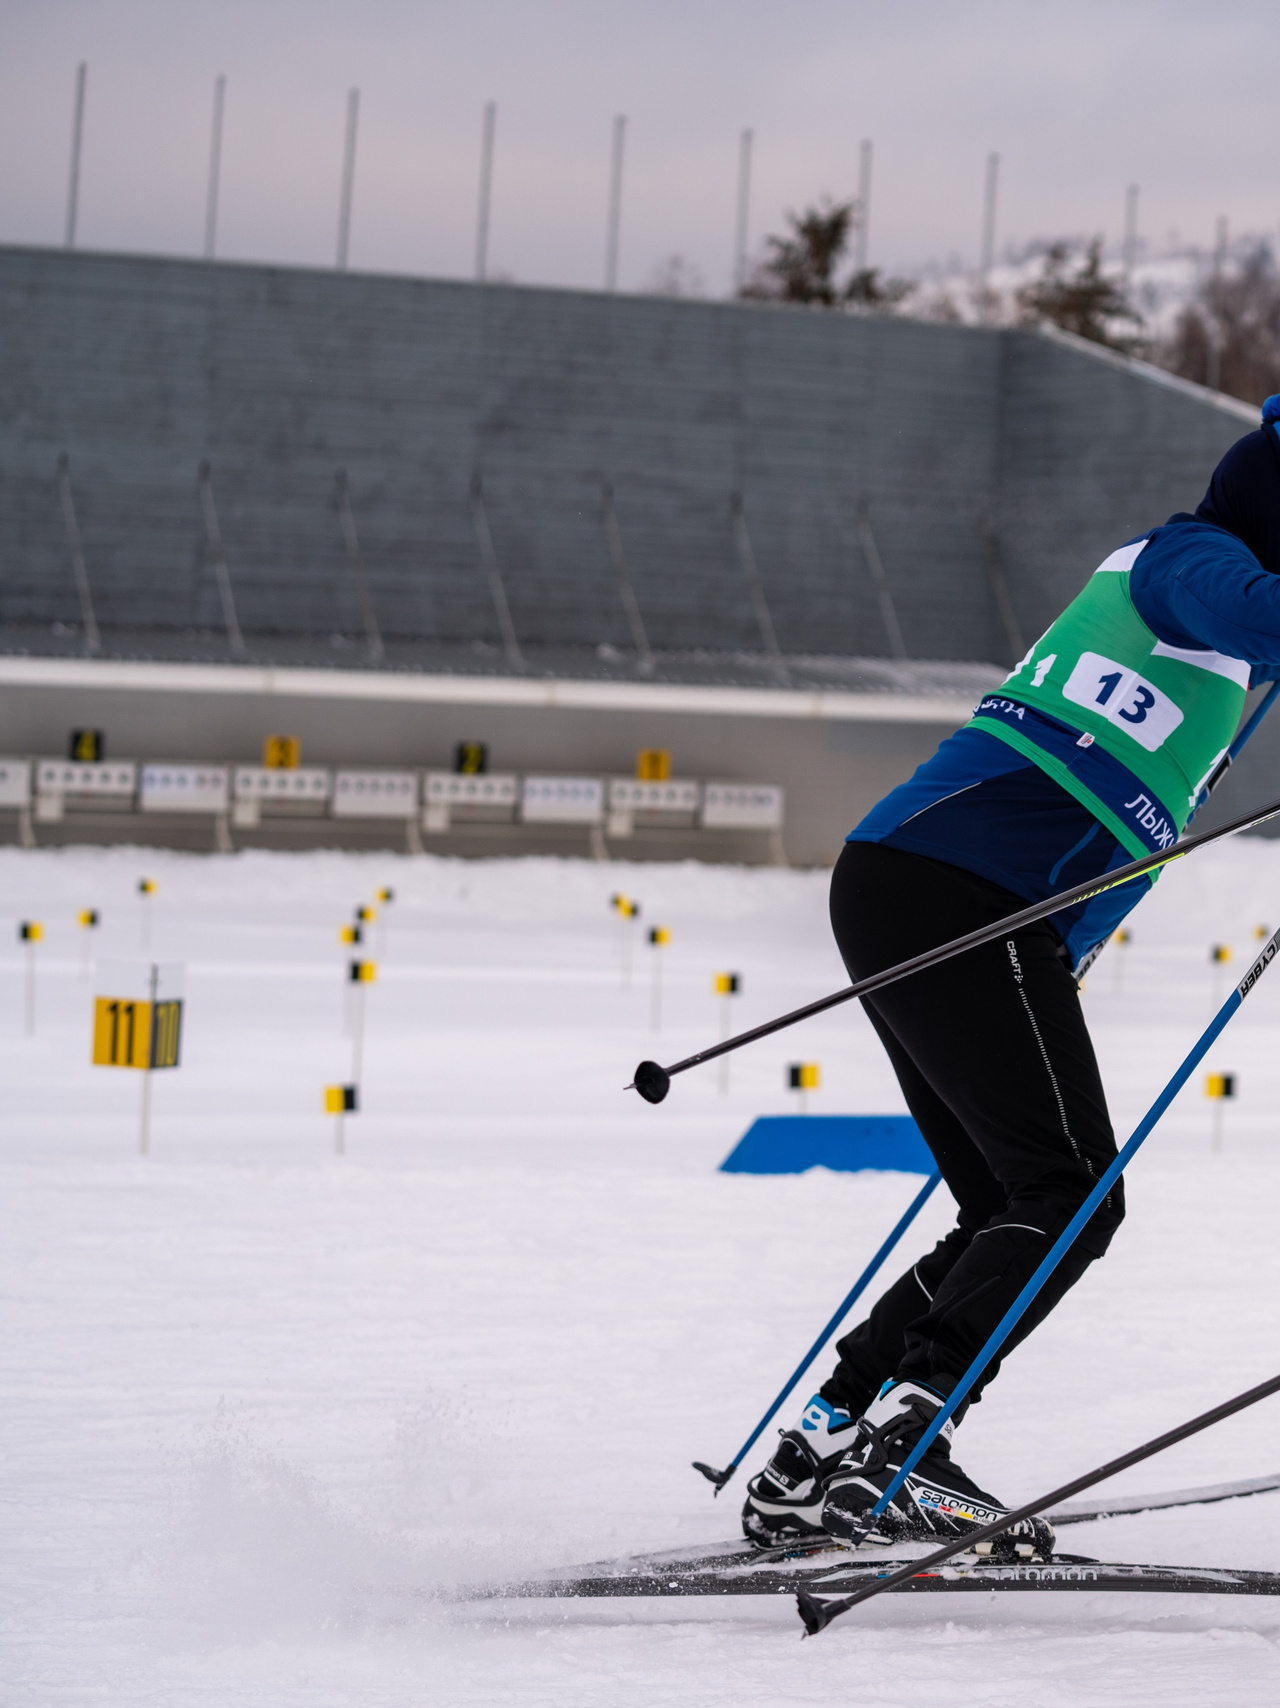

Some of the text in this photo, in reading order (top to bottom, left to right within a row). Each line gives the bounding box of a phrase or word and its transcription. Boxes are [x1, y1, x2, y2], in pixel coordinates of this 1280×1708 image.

[1030, 653, 1058, 688] 1
[1095, 671, 1156, 724] 13
[1006, 940, 1022, 974] CRAFT
[1240, 943, 1276, 997] CYBER
[108, 1001, 136, 1065] 11
[920, 1489, 998, 1522] salomon
